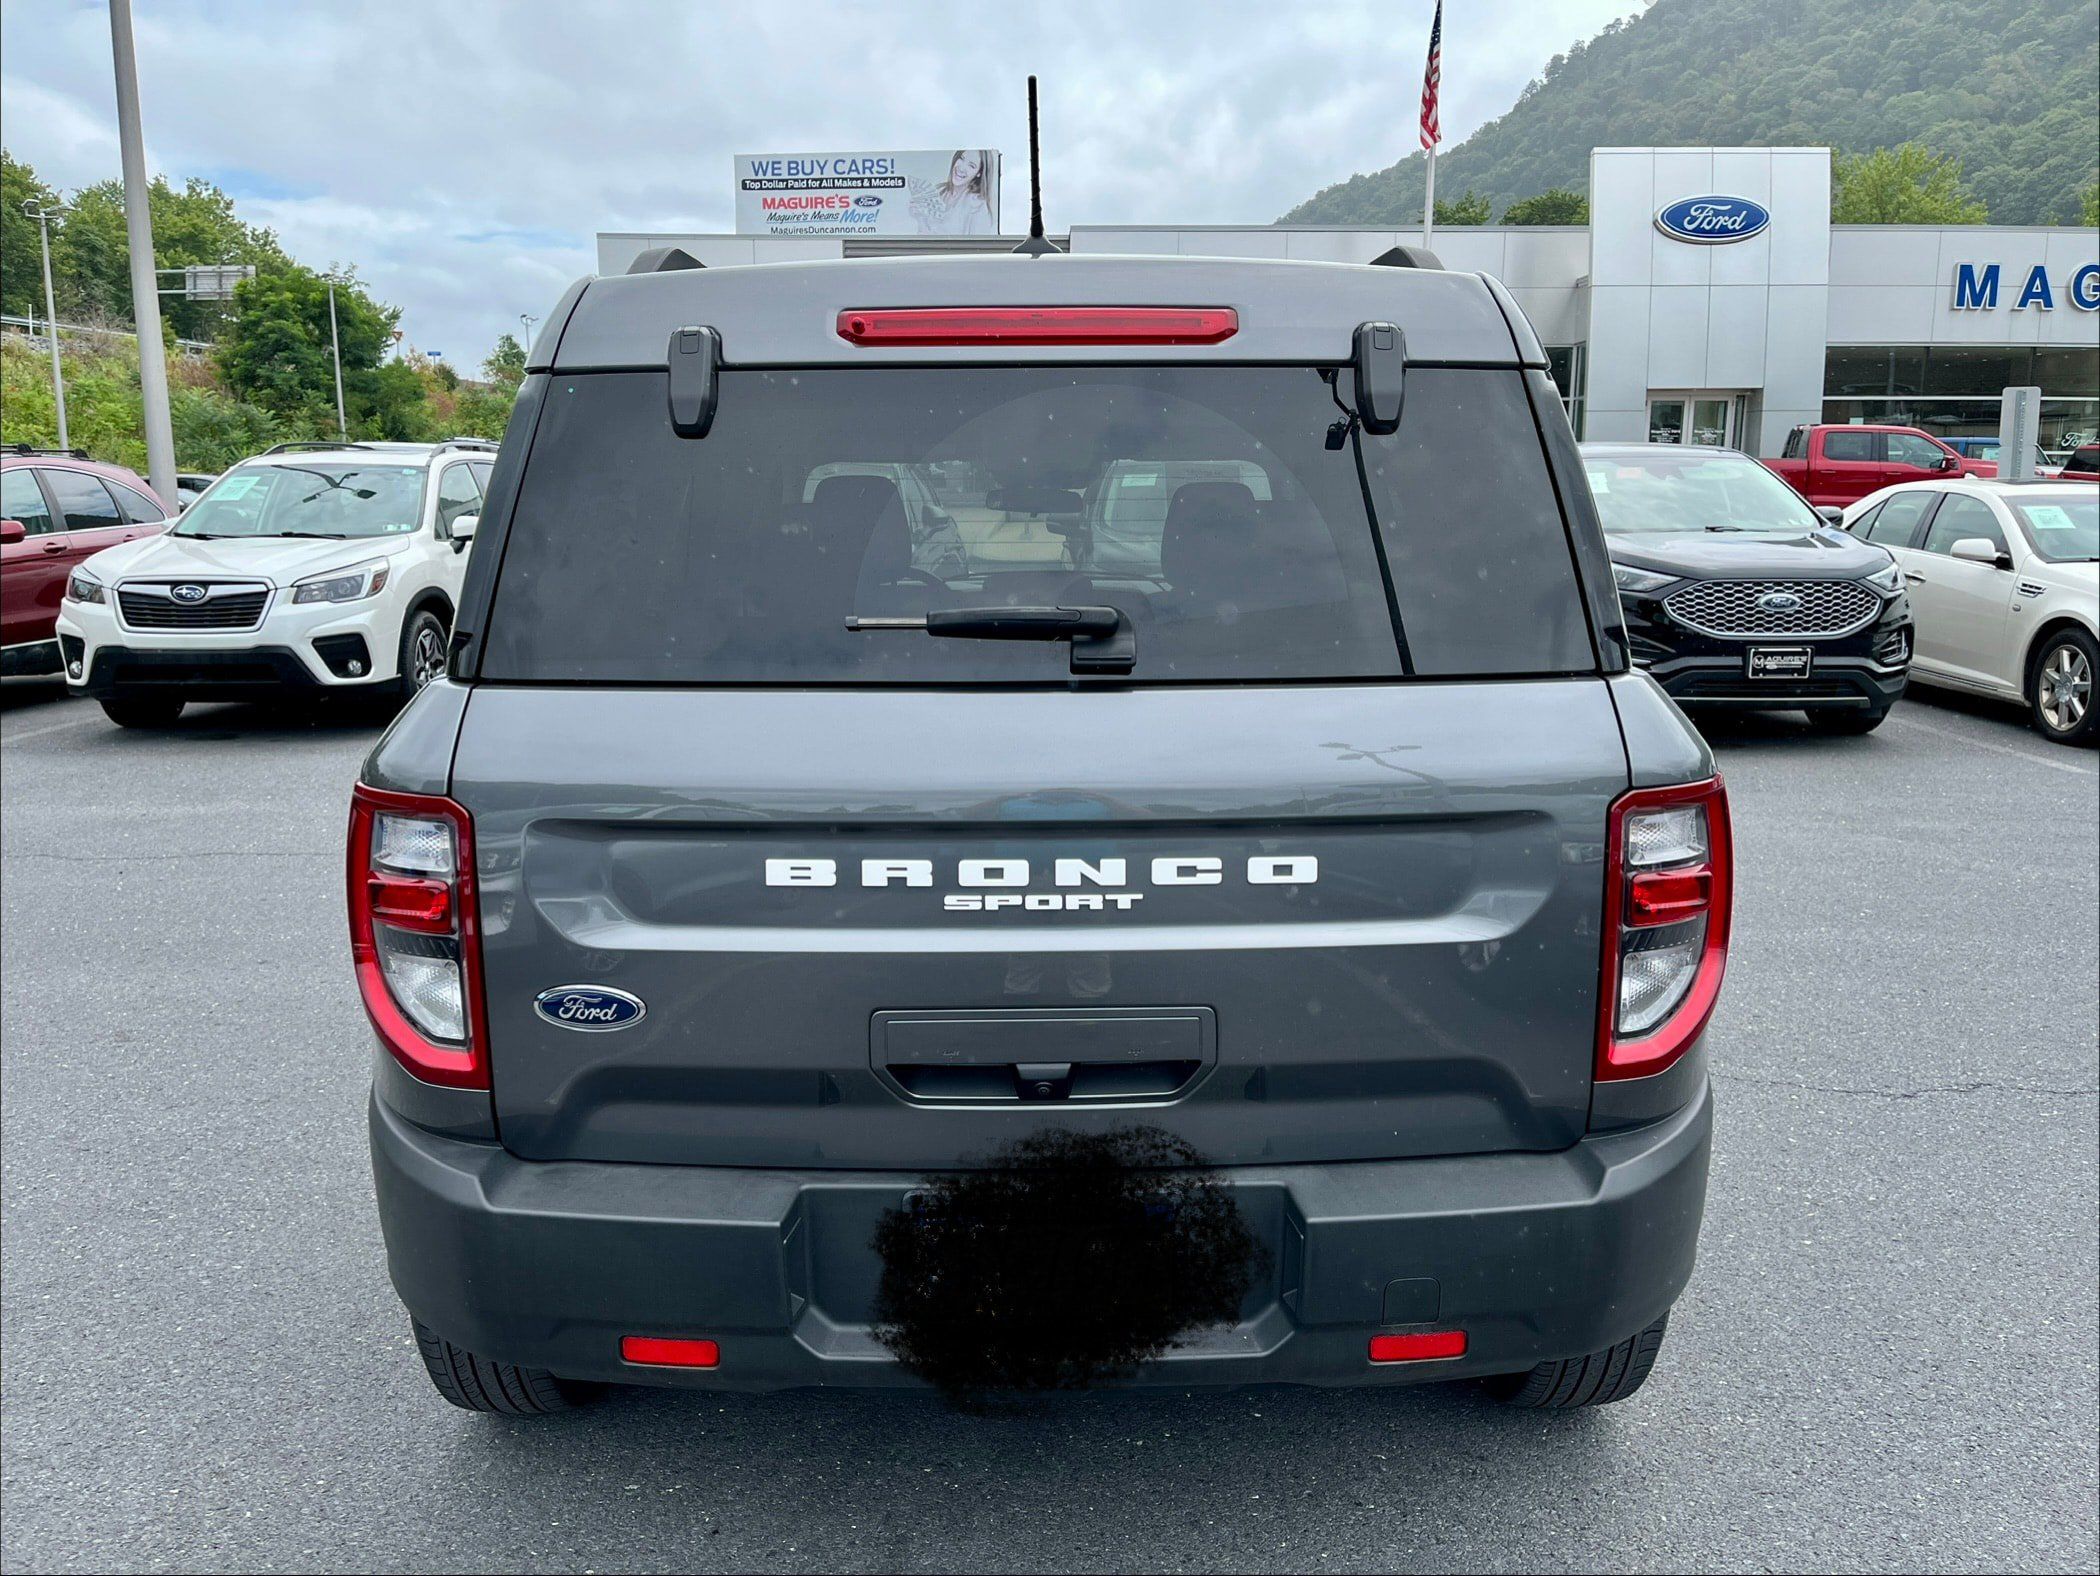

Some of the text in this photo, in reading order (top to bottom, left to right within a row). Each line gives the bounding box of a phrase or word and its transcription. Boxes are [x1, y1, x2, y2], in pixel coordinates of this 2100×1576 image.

[751, 158, 895, 177] WE BUY CARS!
[745, 177, 903, 189] Top Dollar Paid for All Makes & Models
[762, 194, 850, 209] MAGUIRE'S
[767, 209, 880, 224] Maguire's Means More!
[1683, 203, 1748, 231] Ford
[770, 226, 876, 235] MaguiresDuncannon.com
[765, 856, 1318, 887] BRONCO
[943, 893, 1143, 911] SPORT
[558, 994, 618, 1020] Ford
